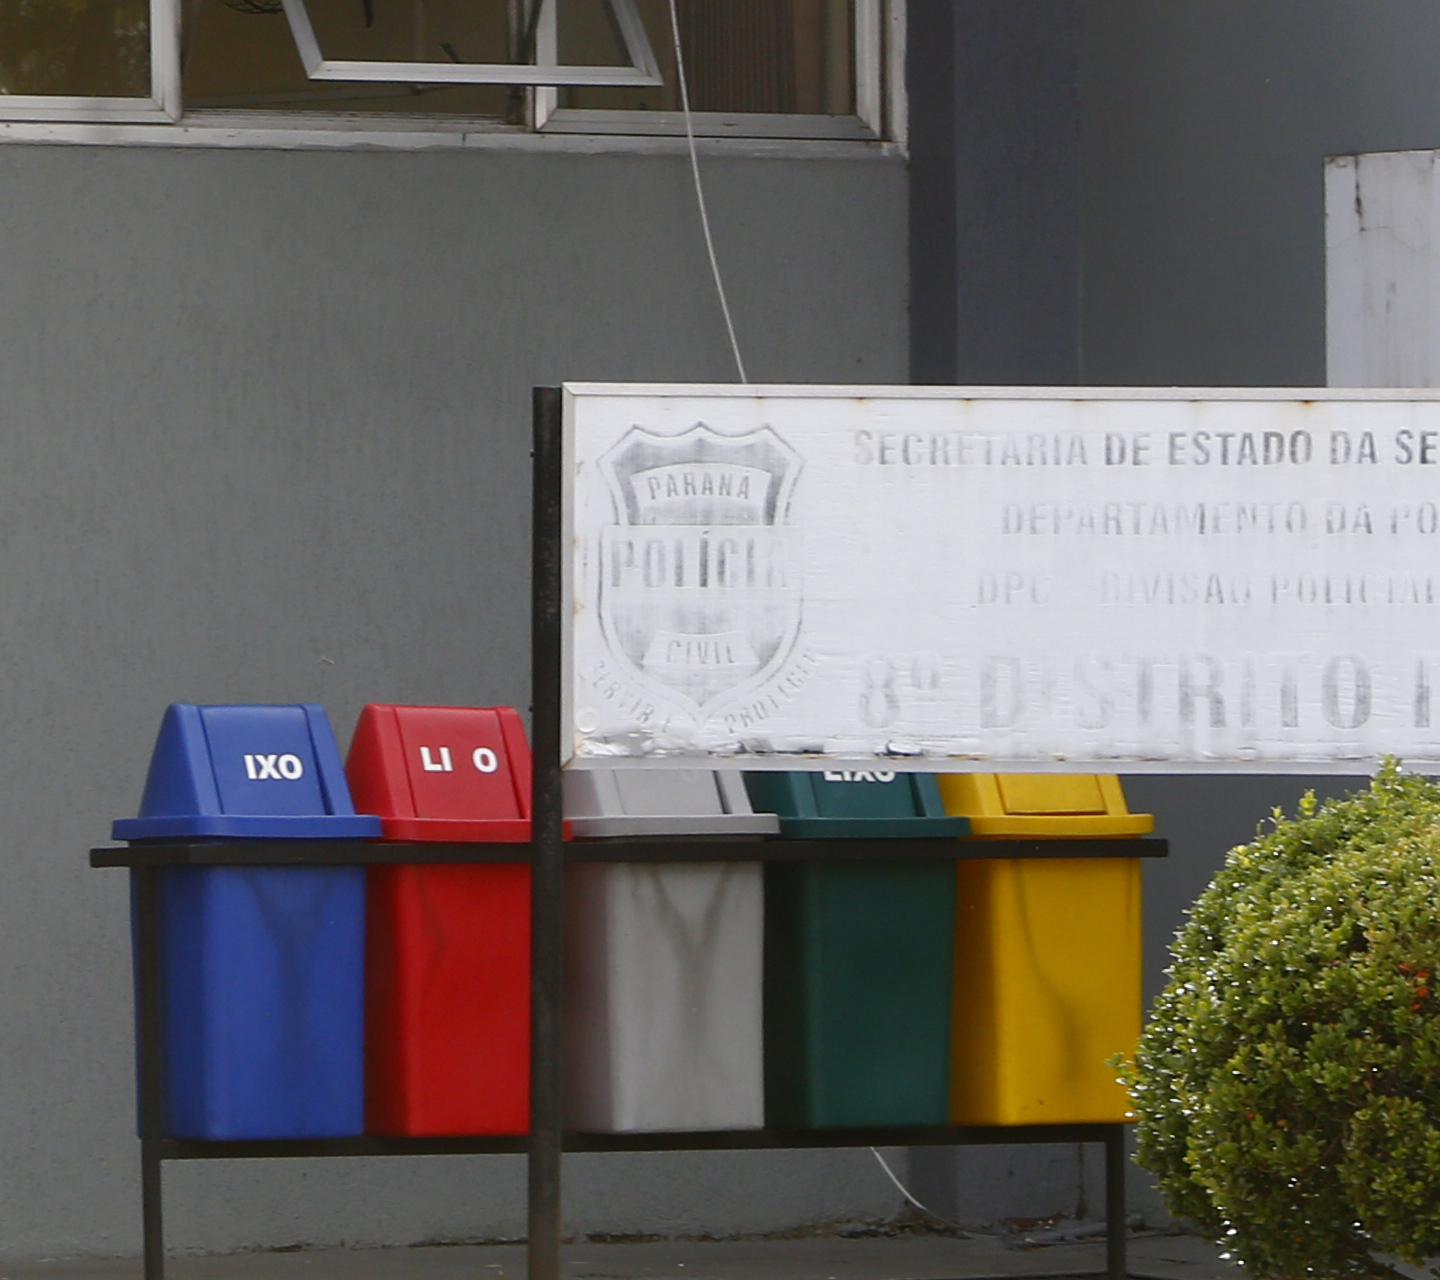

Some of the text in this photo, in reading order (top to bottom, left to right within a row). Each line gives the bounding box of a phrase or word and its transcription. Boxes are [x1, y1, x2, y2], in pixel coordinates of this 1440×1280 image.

[853, 429, 1088, 467] SECRETARIA
[1103, 430, 1152, 467] DE
[1167, 430, 1313, 467] ESTADO
[1327, 429, 1379, 466] DA
[1000, 501, 1307, 536] DEPARTAMENTO
[1325, 501, 1375, 536] DA
